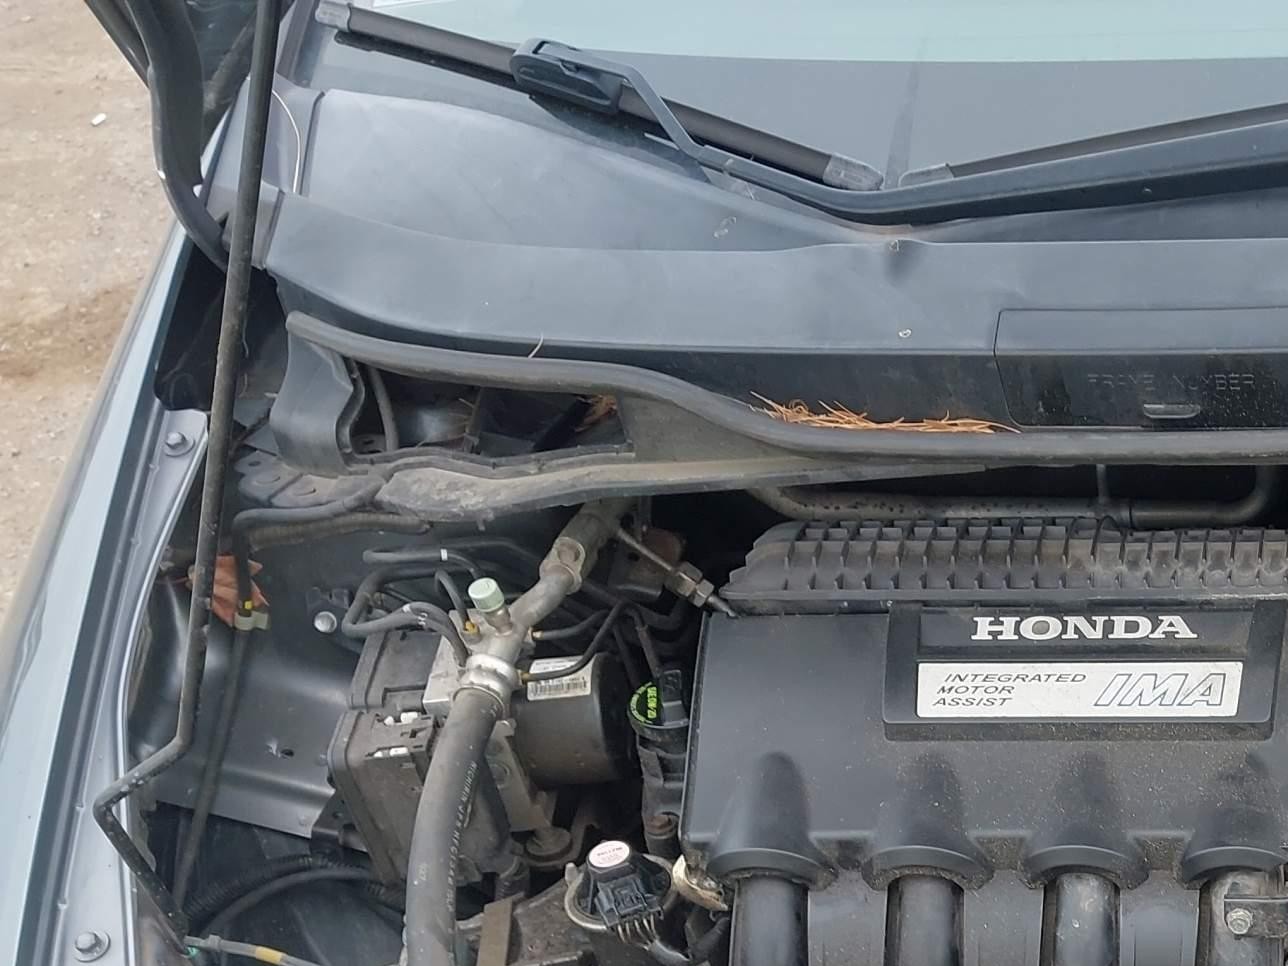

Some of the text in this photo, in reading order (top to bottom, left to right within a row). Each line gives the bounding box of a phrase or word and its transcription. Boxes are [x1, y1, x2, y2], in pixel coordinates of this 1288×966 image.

[1171, 373, 1256, 391] NUMBER
[971, 615, 1197, 641] HONDA
[937, 685, 1016, 695] MOTOR
[944, 672, 1227, 707] INTEGRATED IMA
[932, 697, 1013, 707] ASSIST
